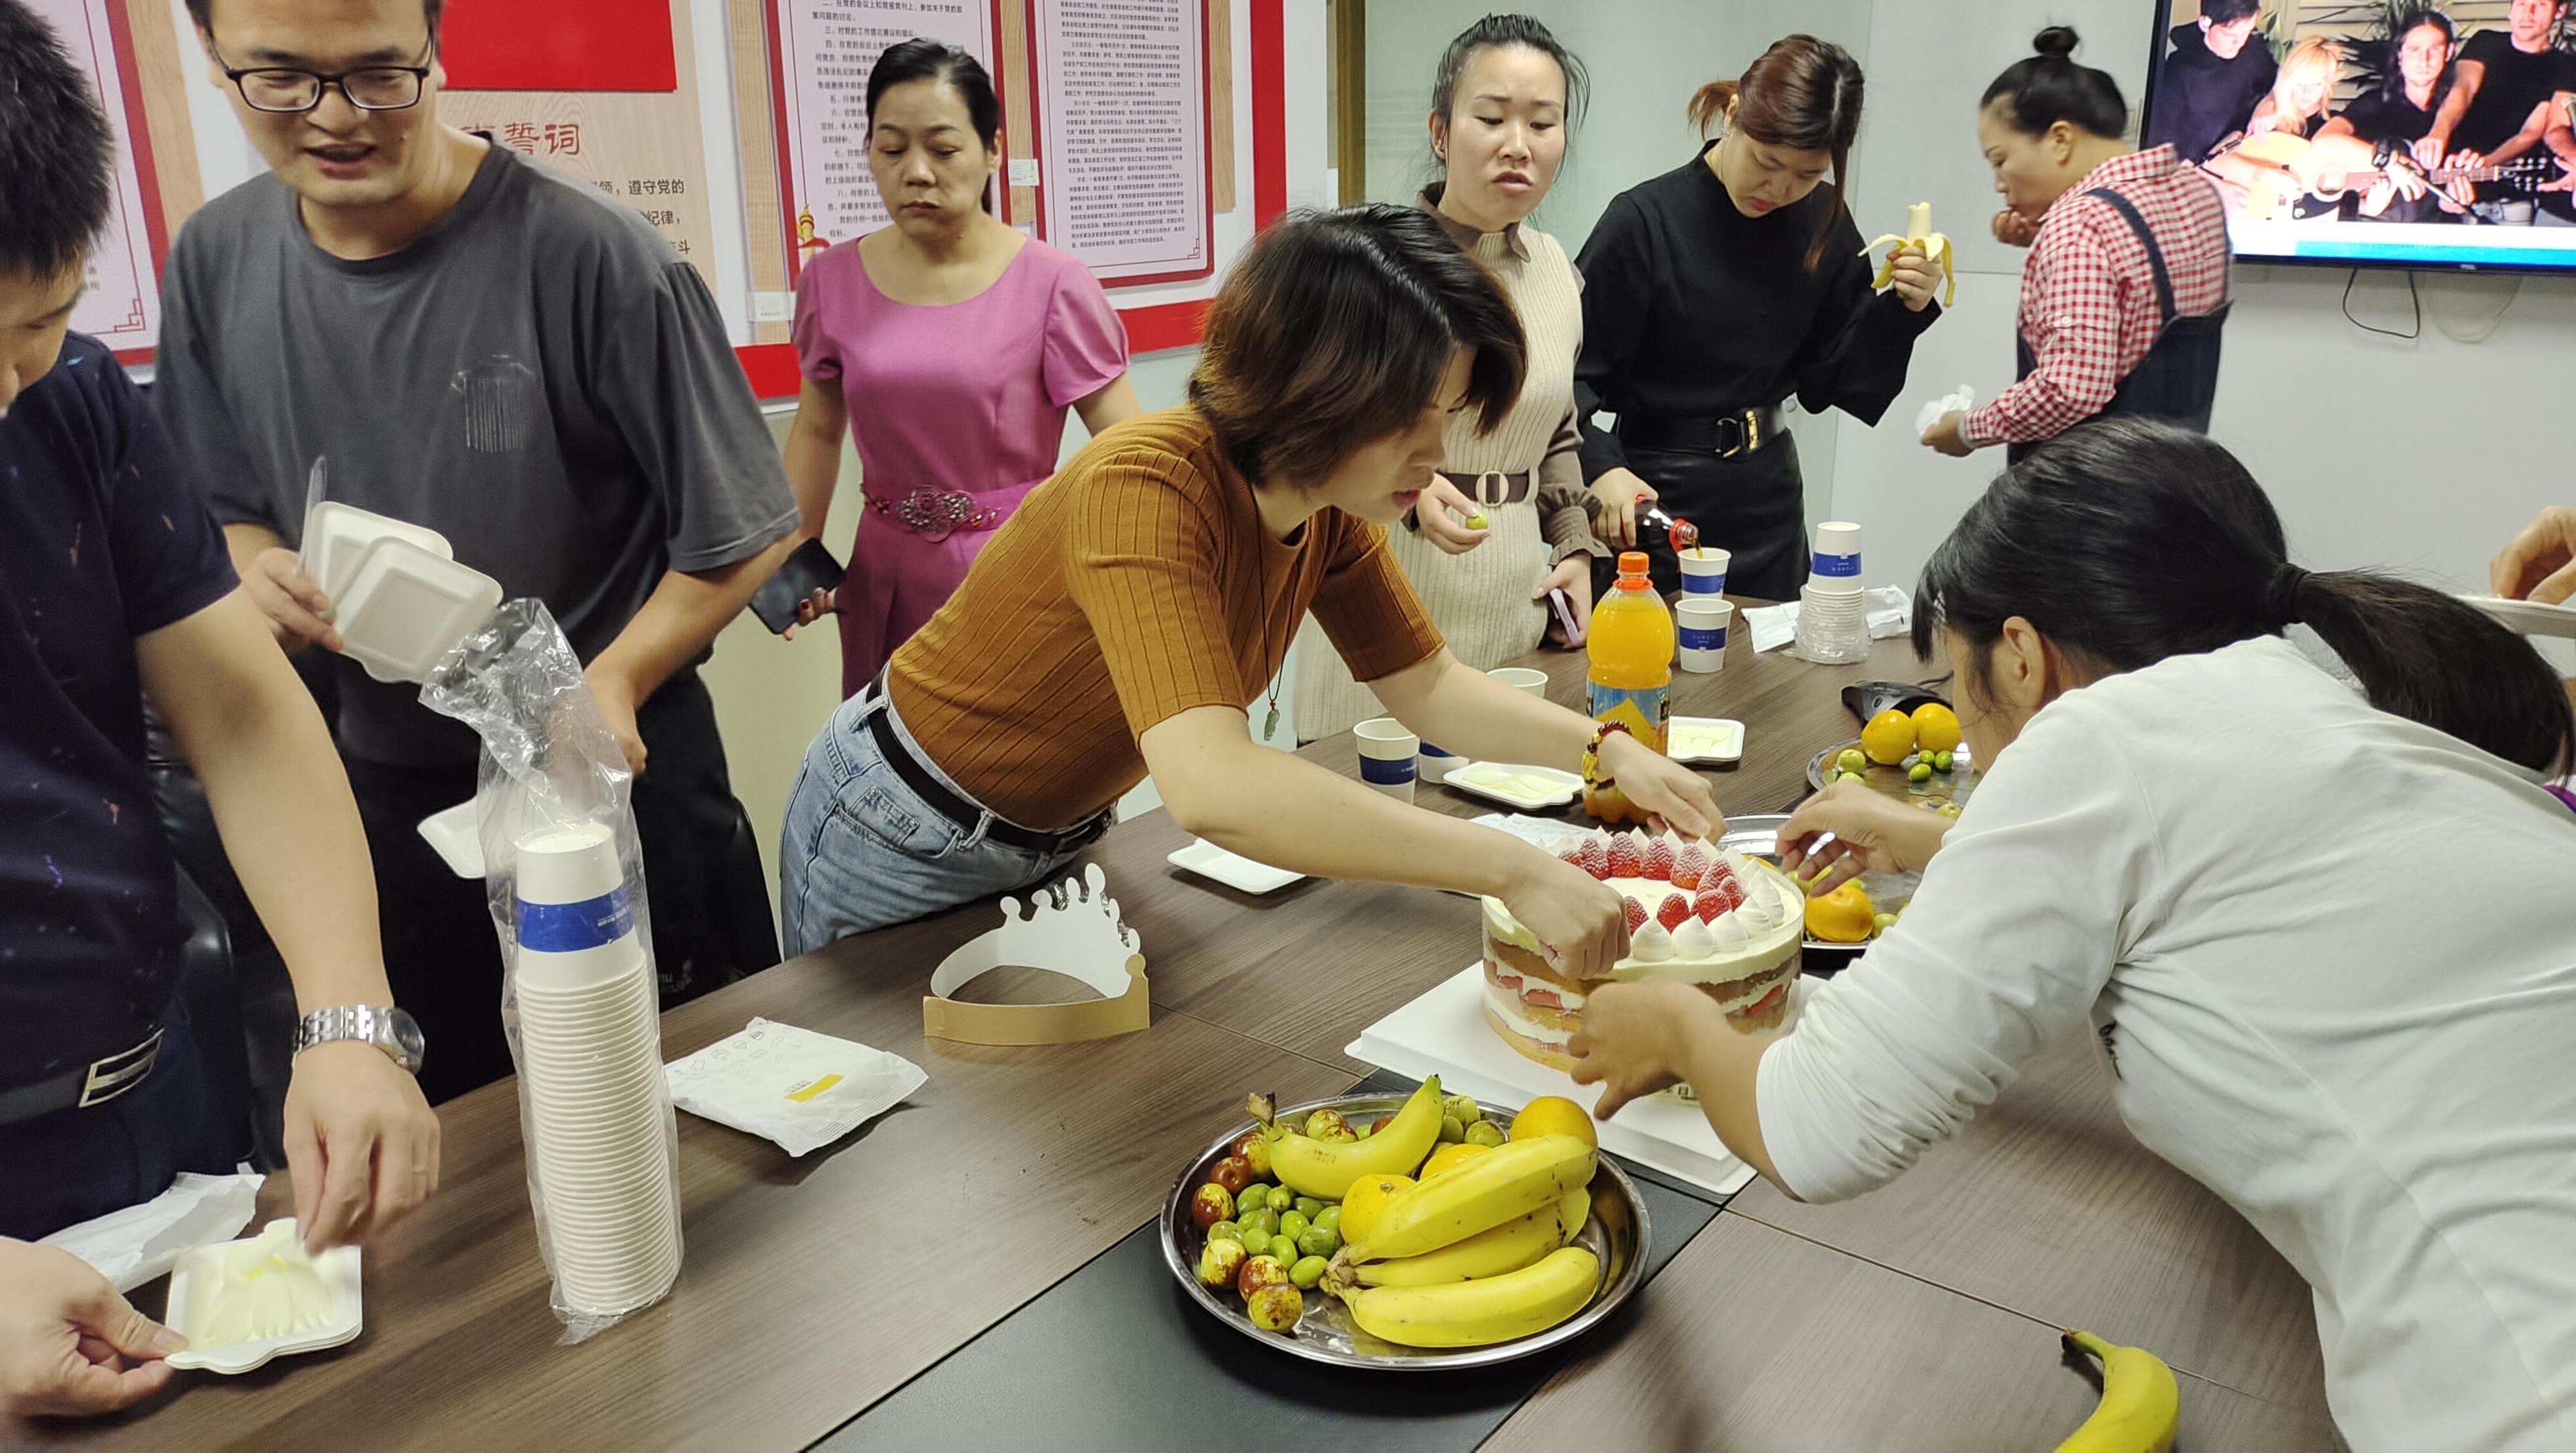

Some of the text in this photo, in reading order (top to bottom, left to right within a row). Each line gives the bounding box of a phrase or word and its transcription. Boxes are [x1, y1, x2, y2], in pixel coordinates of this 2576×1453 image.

[460, 123, 580, 155] 誓词
[591, 178, 685, 195] 领，遵守党的
